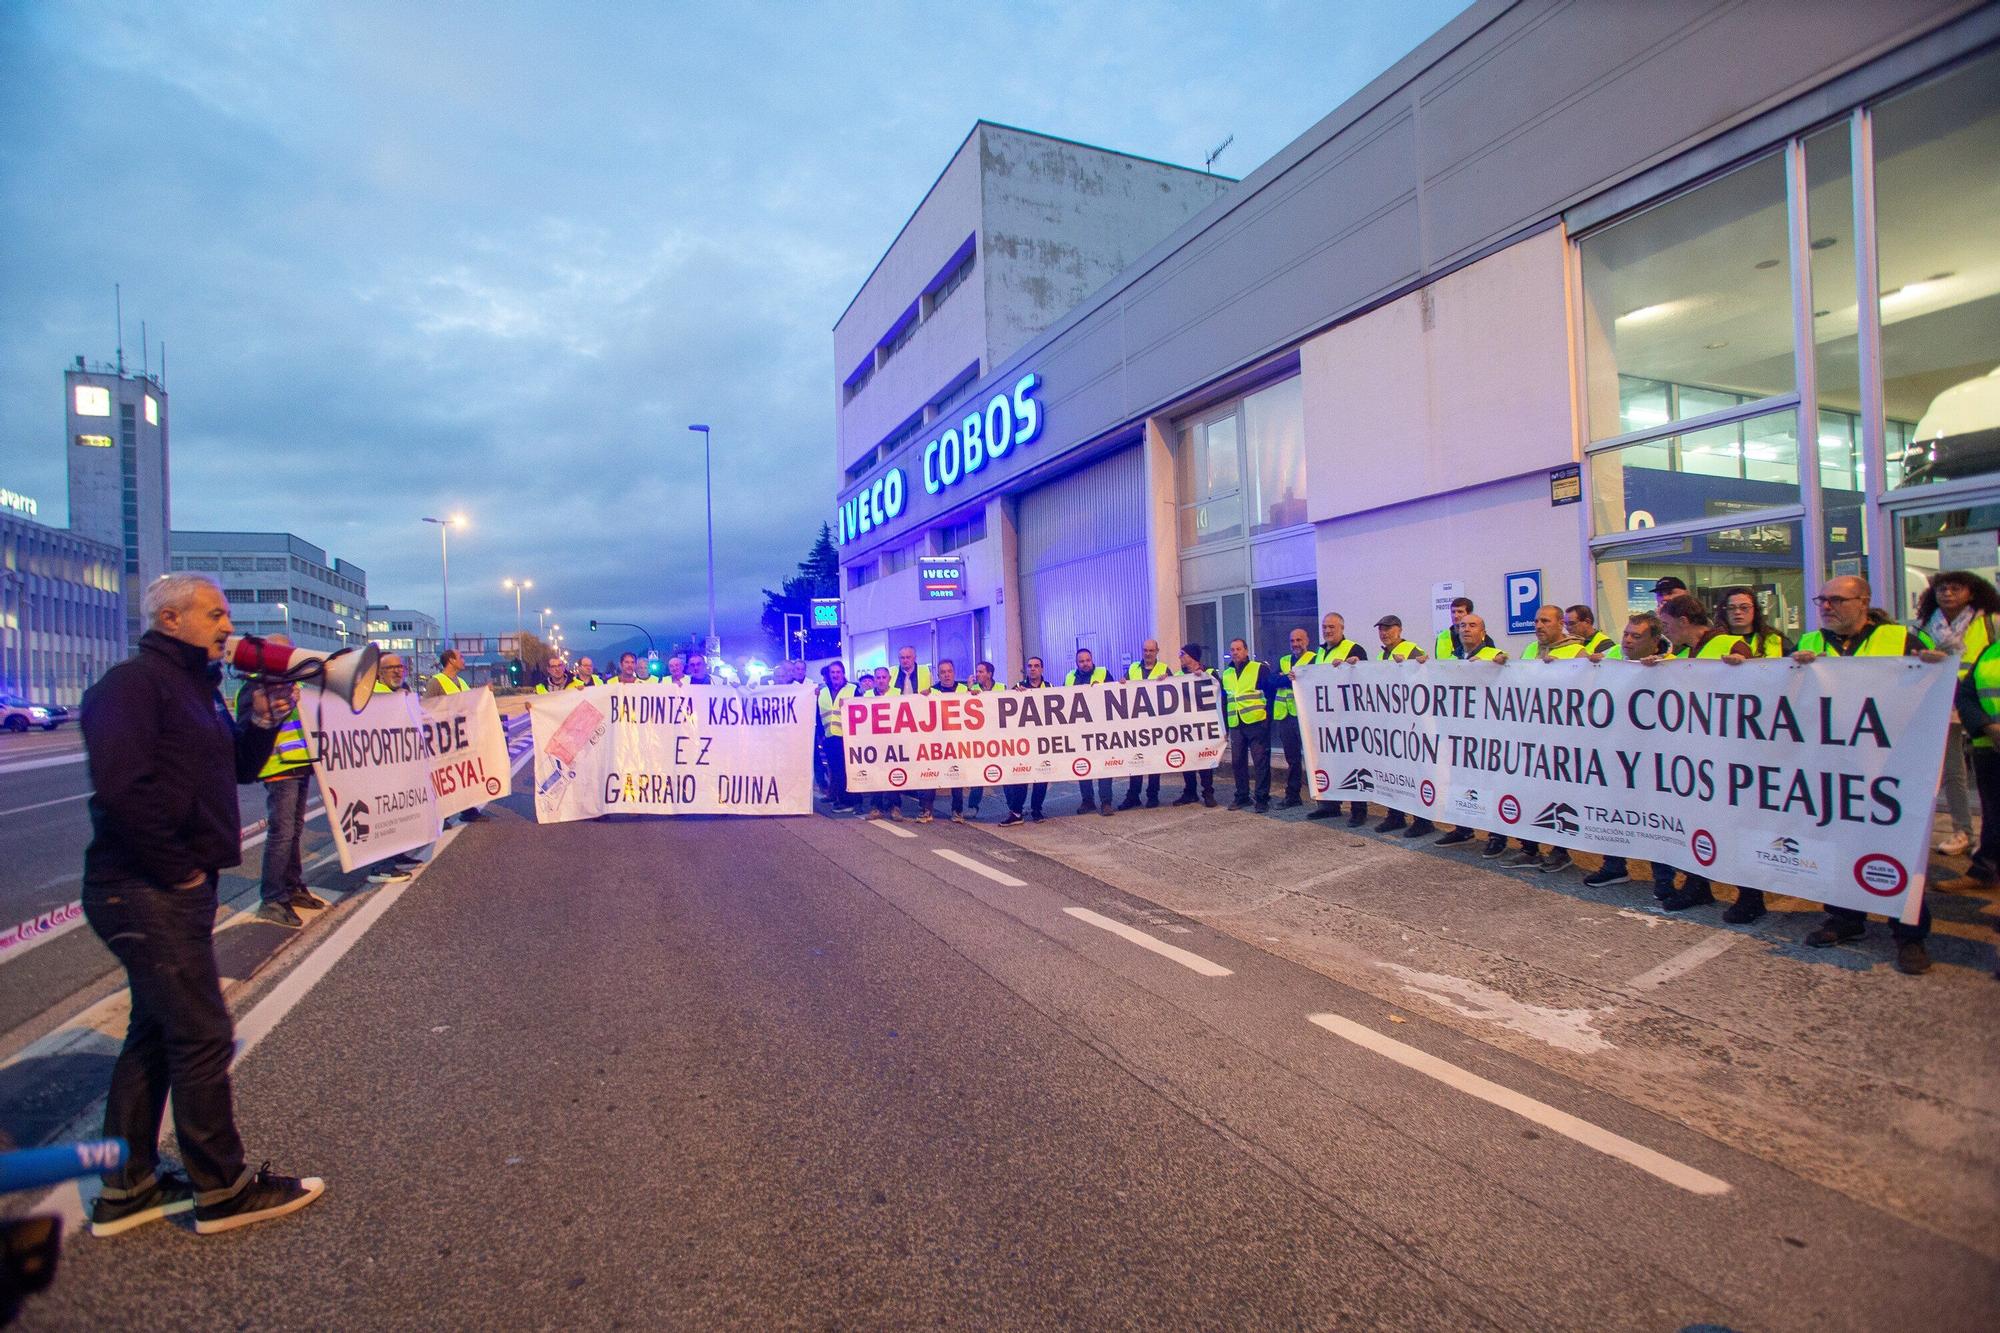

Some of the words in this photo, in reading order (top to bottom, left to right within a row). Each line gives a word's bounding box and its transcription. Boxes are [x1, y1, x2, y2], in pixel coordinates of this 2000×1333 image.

[839, 468, 904, 545] IVECO
[924, 373, 1038, 494] COBOS
[0, 488, 37, 515] avarra
[923, 569, 959, 579] IVECO
[1510, 577, 1537, 617] P
[610, 695, 696, 725] BALDINTZA
[848, 698, 985, 736] PEAJES
[998, 692, 1093, 729] PARA
[1104, 679, 1217, 721] NADIE
[1315, 685, 1334, 713] EL
[1337, 683, 1476, 719] TRANSPORTE
[1484, 686, 1615, 729] NAVARRO
[1628, 688, 1805, 743] CONTRA
[1819, 696, 1892, 748] LA
[849, 746, 877, 765] NO
[885, 745, 909, 762] AL
[916, 738, 1030, 762] ABANDONO
[1038, 735, 1075, 755] DEL
[1082, 721, 1220, 751] TRANSPORTE
[605, 772, 695, 804] GARRAIO
[718, 775, 779, 804] DUINA
[1318, 722, 1440, 765] IMPOSICIÓN
[1448, 734, 1608, 787] TRIBUTARIA
[1616, 750, 1641, 789] Y
[1654, 752, 1715, 802] LOS
[1728, 762, 1901, 827] PEAJES
[1594, 834, 1631, 845] NAVARRA
